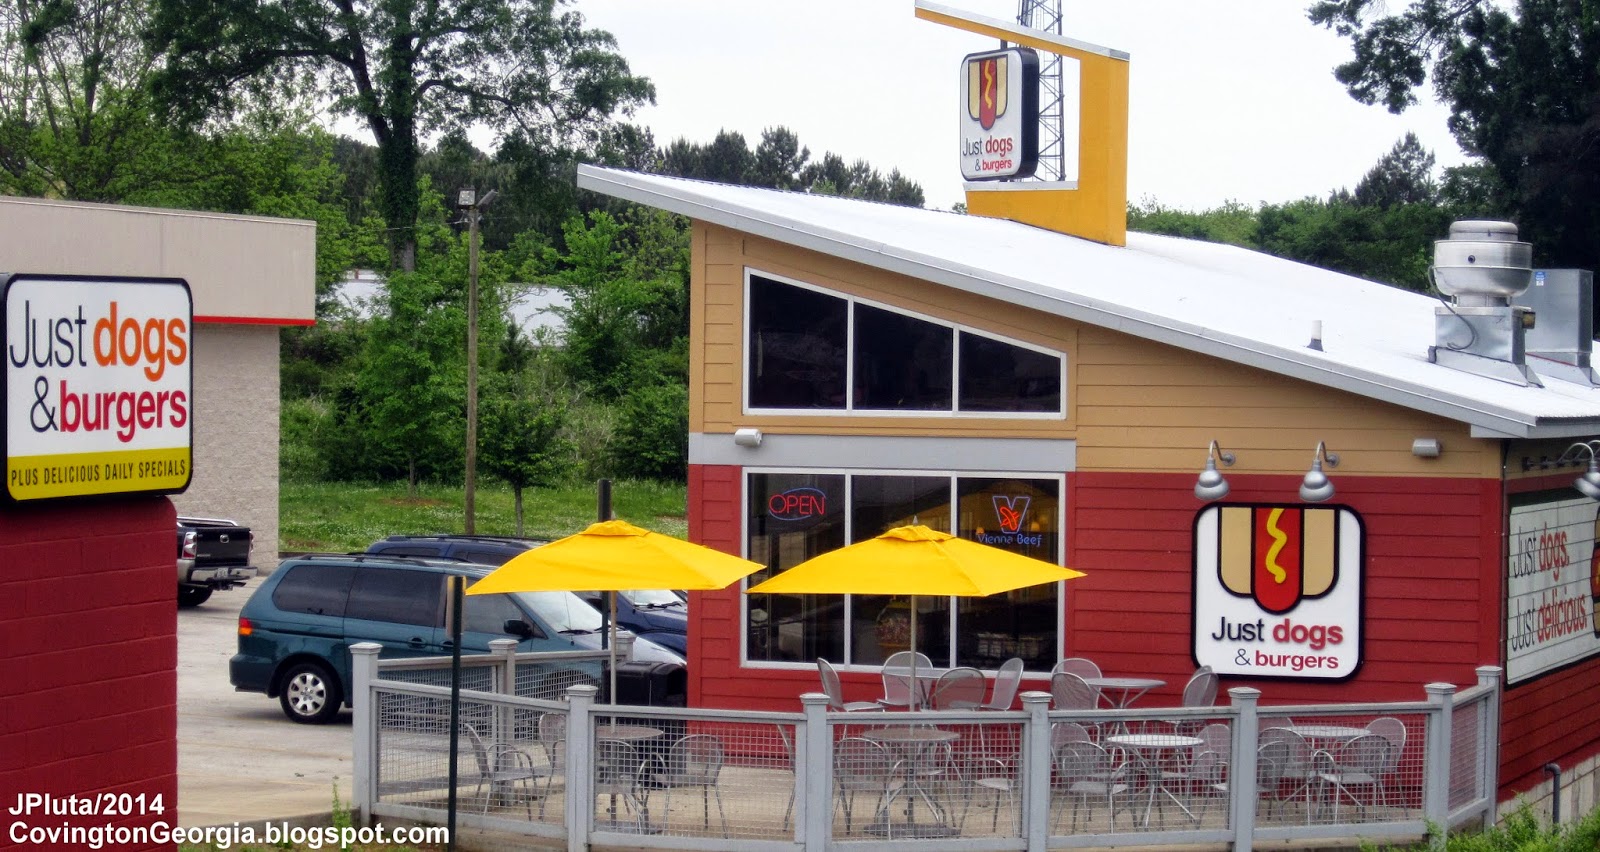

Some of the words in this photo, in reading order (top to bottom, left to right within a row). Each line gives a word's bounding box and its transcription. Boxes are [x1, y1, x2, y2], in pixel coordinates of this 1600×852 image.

[963, 137, 982, 156] Just
[985, 135, 1013, 157] dogs
[975, 159, 981, 171] &
[982, 159, 1012, 172] burgers
[9, 300, 87, 368] Just
[93, 301, 187, 382] dogs
[11, 469, 38, 487] PLUS
[43, 464, 100, 485] DELICIOUS
[104, 462, 134, 481] DAILY
[138, 459, 186, 479] SPECIALS
[769, 494, 825, 515] OPEN
[977, 533, 1014, 544] Vienna
[1016, 533, 1042, 548] Beef
[1513, 526, 1537, 578] Just
[1212, 617, 1265, 642] Just
[1272, 618, 1344, 650] dogs
[1512, 598, 1535, 652] Just
[1234, 648, 1251, 666] &
[1255, 650, 1339, 672] burgers
